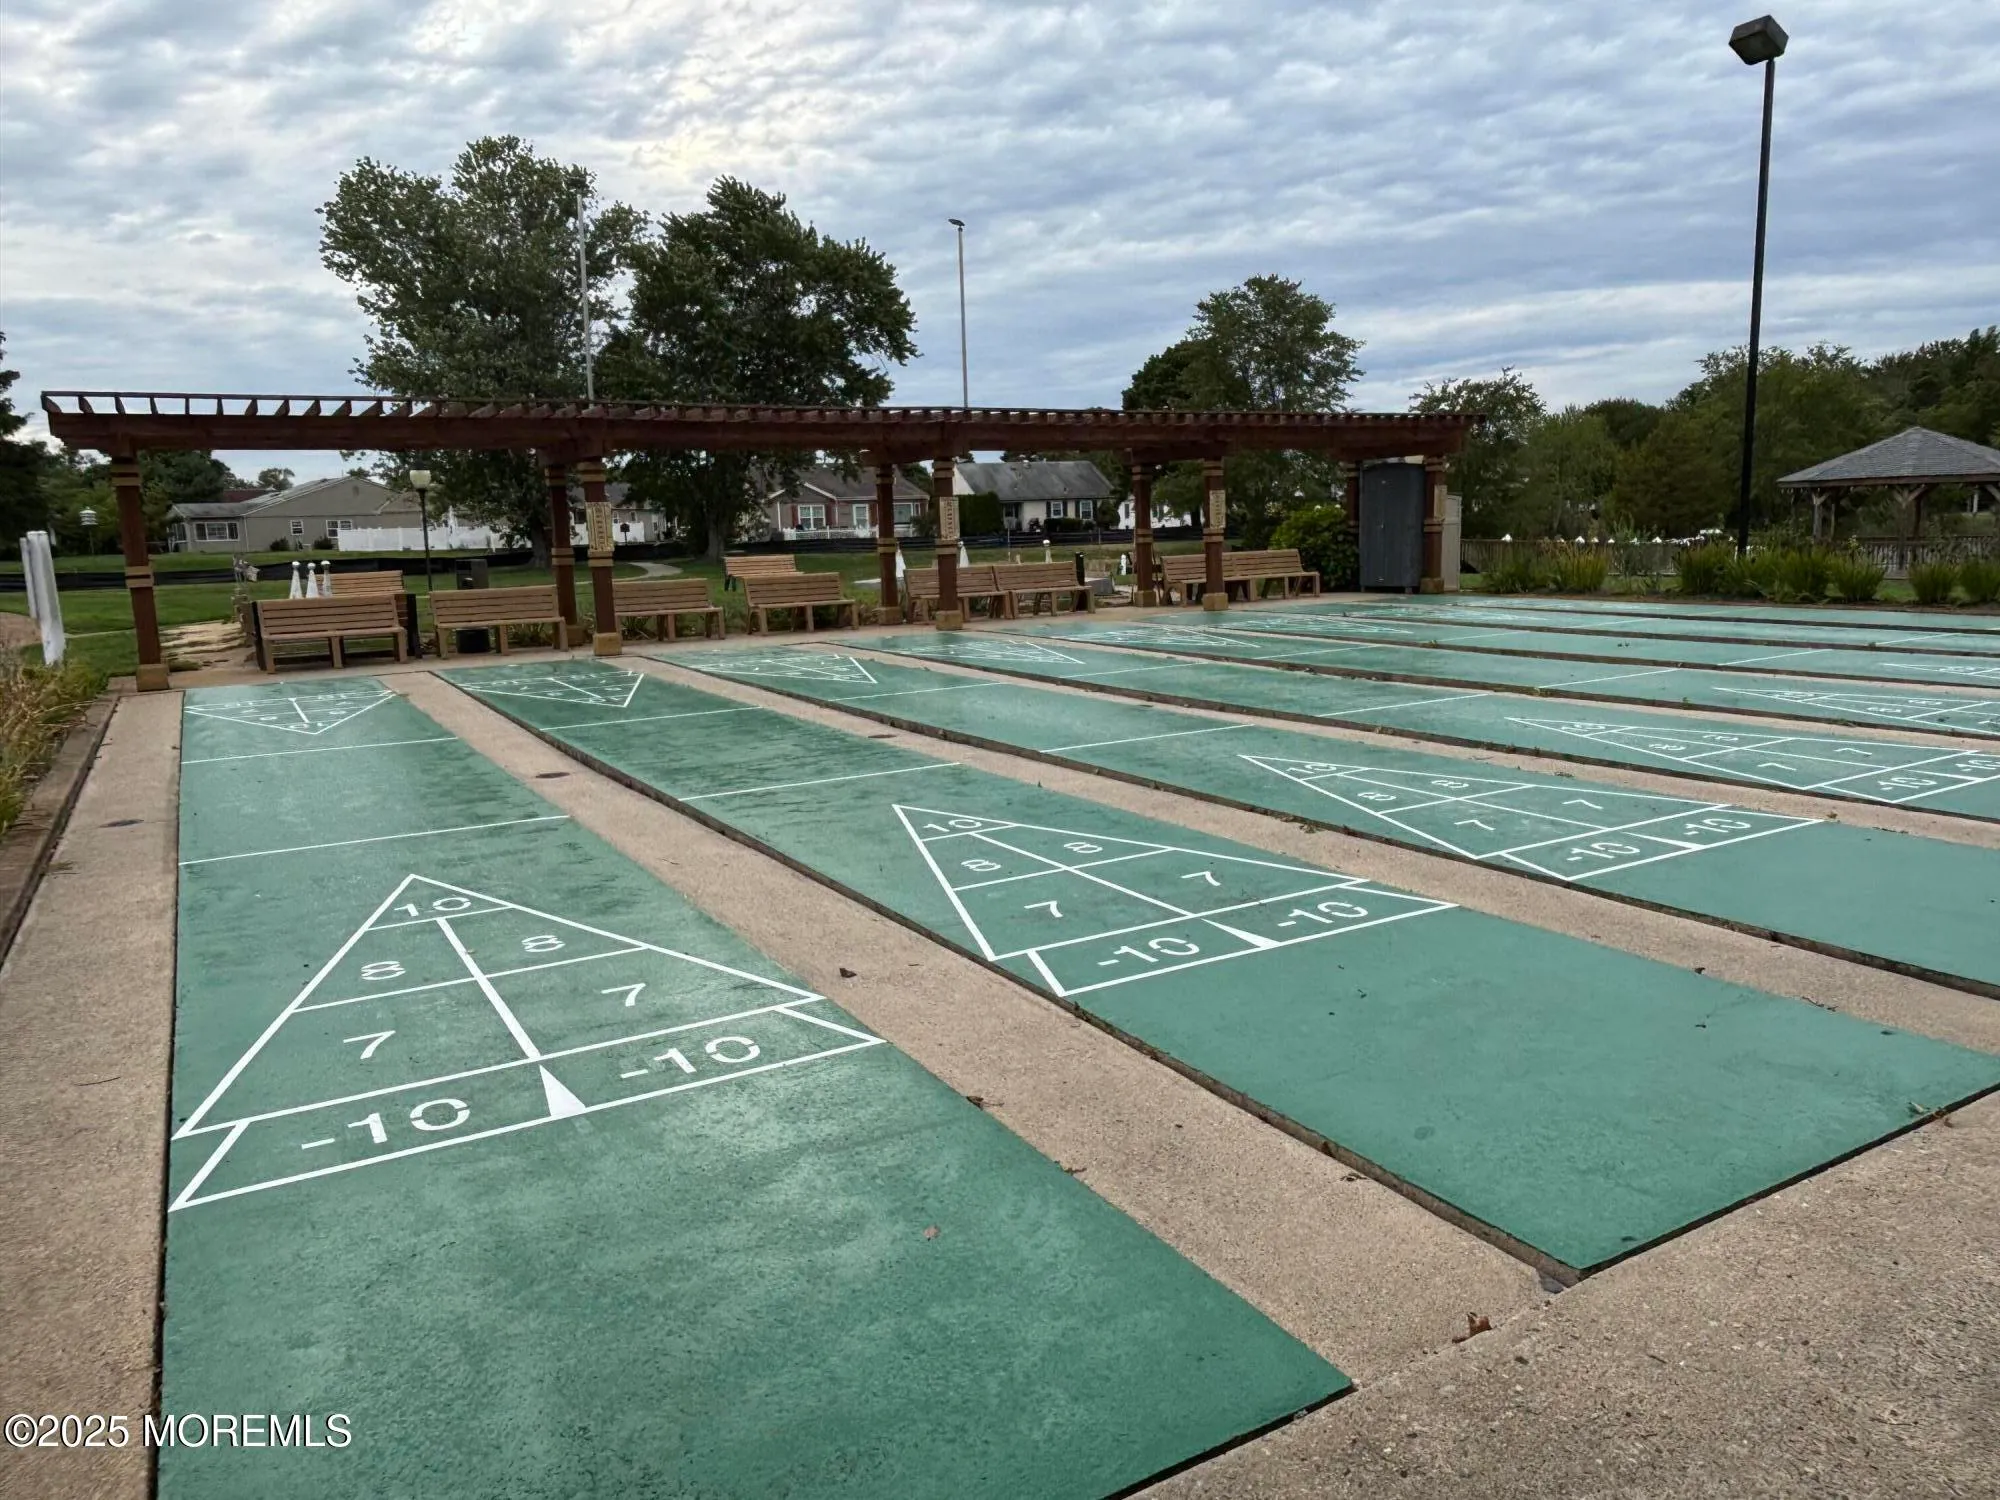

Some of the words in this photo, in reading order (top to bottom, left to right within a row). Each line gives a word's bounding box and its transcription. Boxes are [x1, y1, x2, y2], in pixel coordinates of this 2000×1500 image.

[1432, 779, 1469, 789] 8
[1358, 791, 1397, 801] 8
[1563, 799, 1603, 810] 7
[922, 819, 983, 832] 10
[1454, 819, 1494, 831] 7
[1063, 841, 1103, 853] 8
[960, 859, 1002, 872] 8
[1181, 870, 1221, 887] 7
[394, 896, 472, 917] 10
[1023, 900, 1063, 918] 7
[1278, 901, 1369, 928] -10
[521, 934, 566, 953] 8
[1097, 937, 1200, 966] -10
[361, 960, 406, 981] 8
[601, 982, 646, 1007] 7
[342, 1030, 396, 1060] 7
[620, 1036, 761, 1079] -10
[301, 1098, 471, 1150] -10
